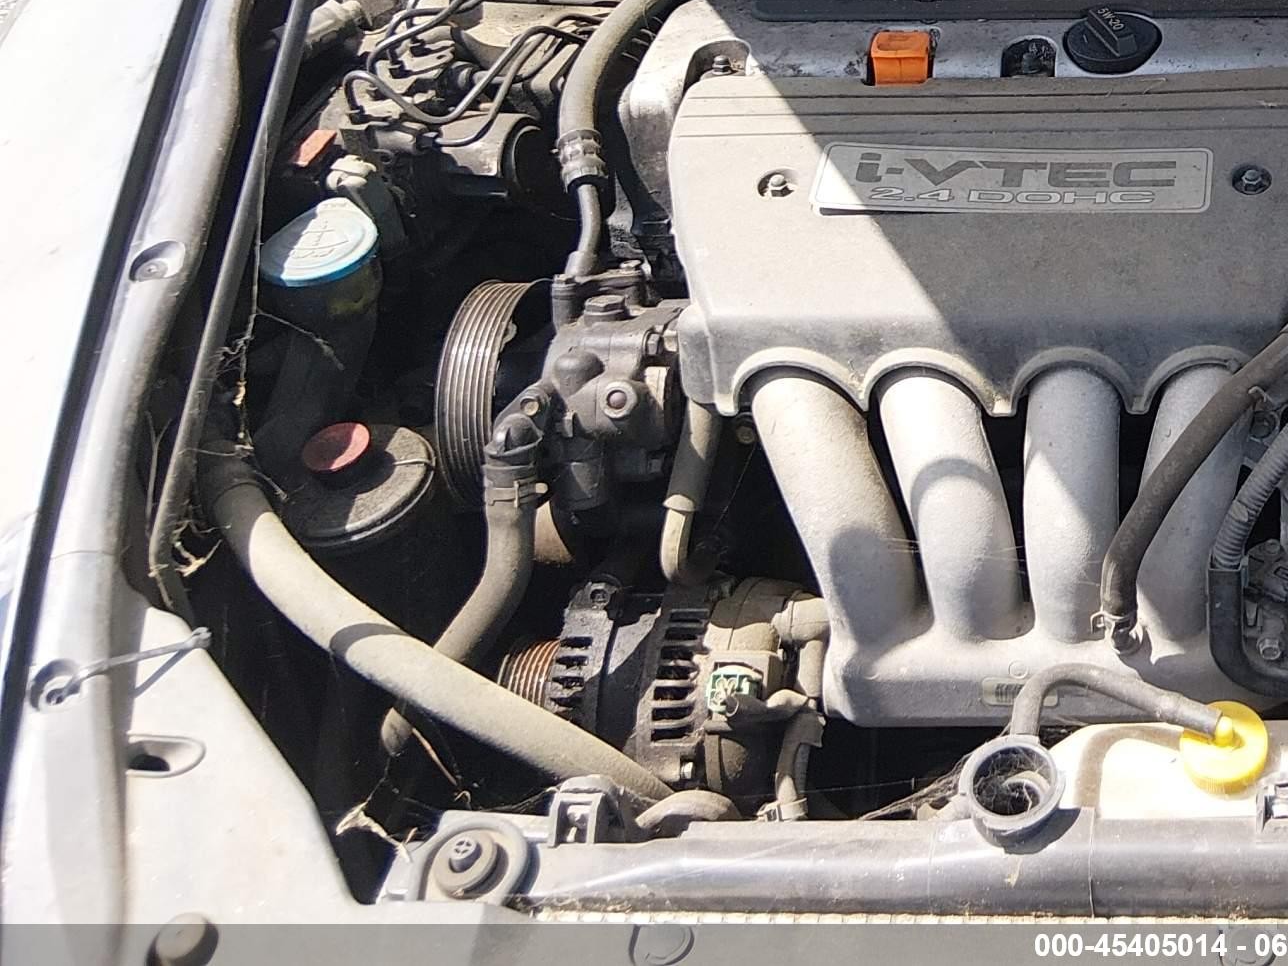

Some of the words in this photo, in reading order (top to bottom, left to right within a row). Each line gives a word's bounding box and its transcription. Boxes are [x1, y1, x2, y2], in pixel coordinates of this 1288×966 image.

[855, 152, 1177, 187] i-VTEC
[869, 186, 954, 202] 2.4
[967, 189, 1155, 204] DOHC
